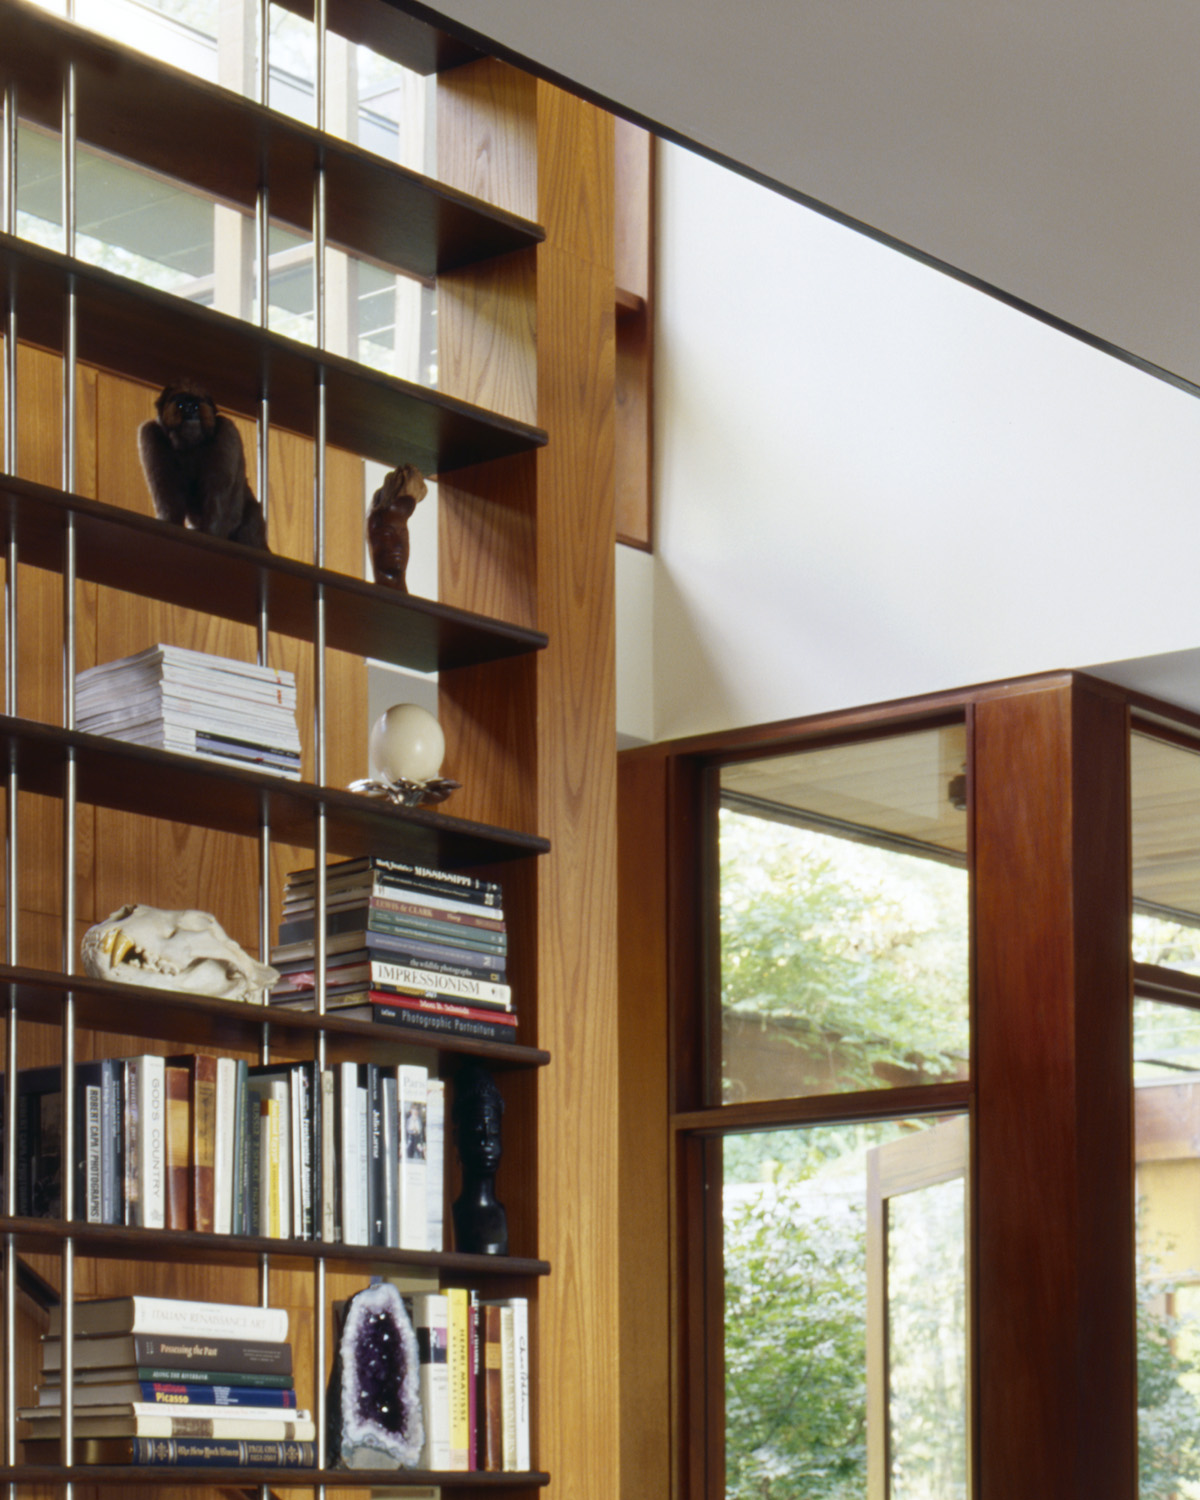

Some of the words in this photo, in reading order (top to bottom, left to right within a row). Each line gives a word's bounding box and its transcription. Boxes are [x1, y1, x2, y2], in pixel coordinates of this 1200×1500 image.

[414, 865, 472, 887] MISSISSIPPI
[377, 964, 480, 996] IMPRESSIONISM
[401, 1009, 451, 1030] Photographic
[90, 1089, 99, 1124] ROBERT
[152, 1078, 160, 1121] GOD'S
[90, 1126, 99, 1147] CAPA
[152, 1128, 161, 1198] COUNTRY
[90, 1154, 100, 1217] PHOTOGRAPHS
[159, 1343, 193, 1359] Possessing
[152, 1382, 188, 1394] Matisse
[155, 1391, 190, 1404] Picasso
